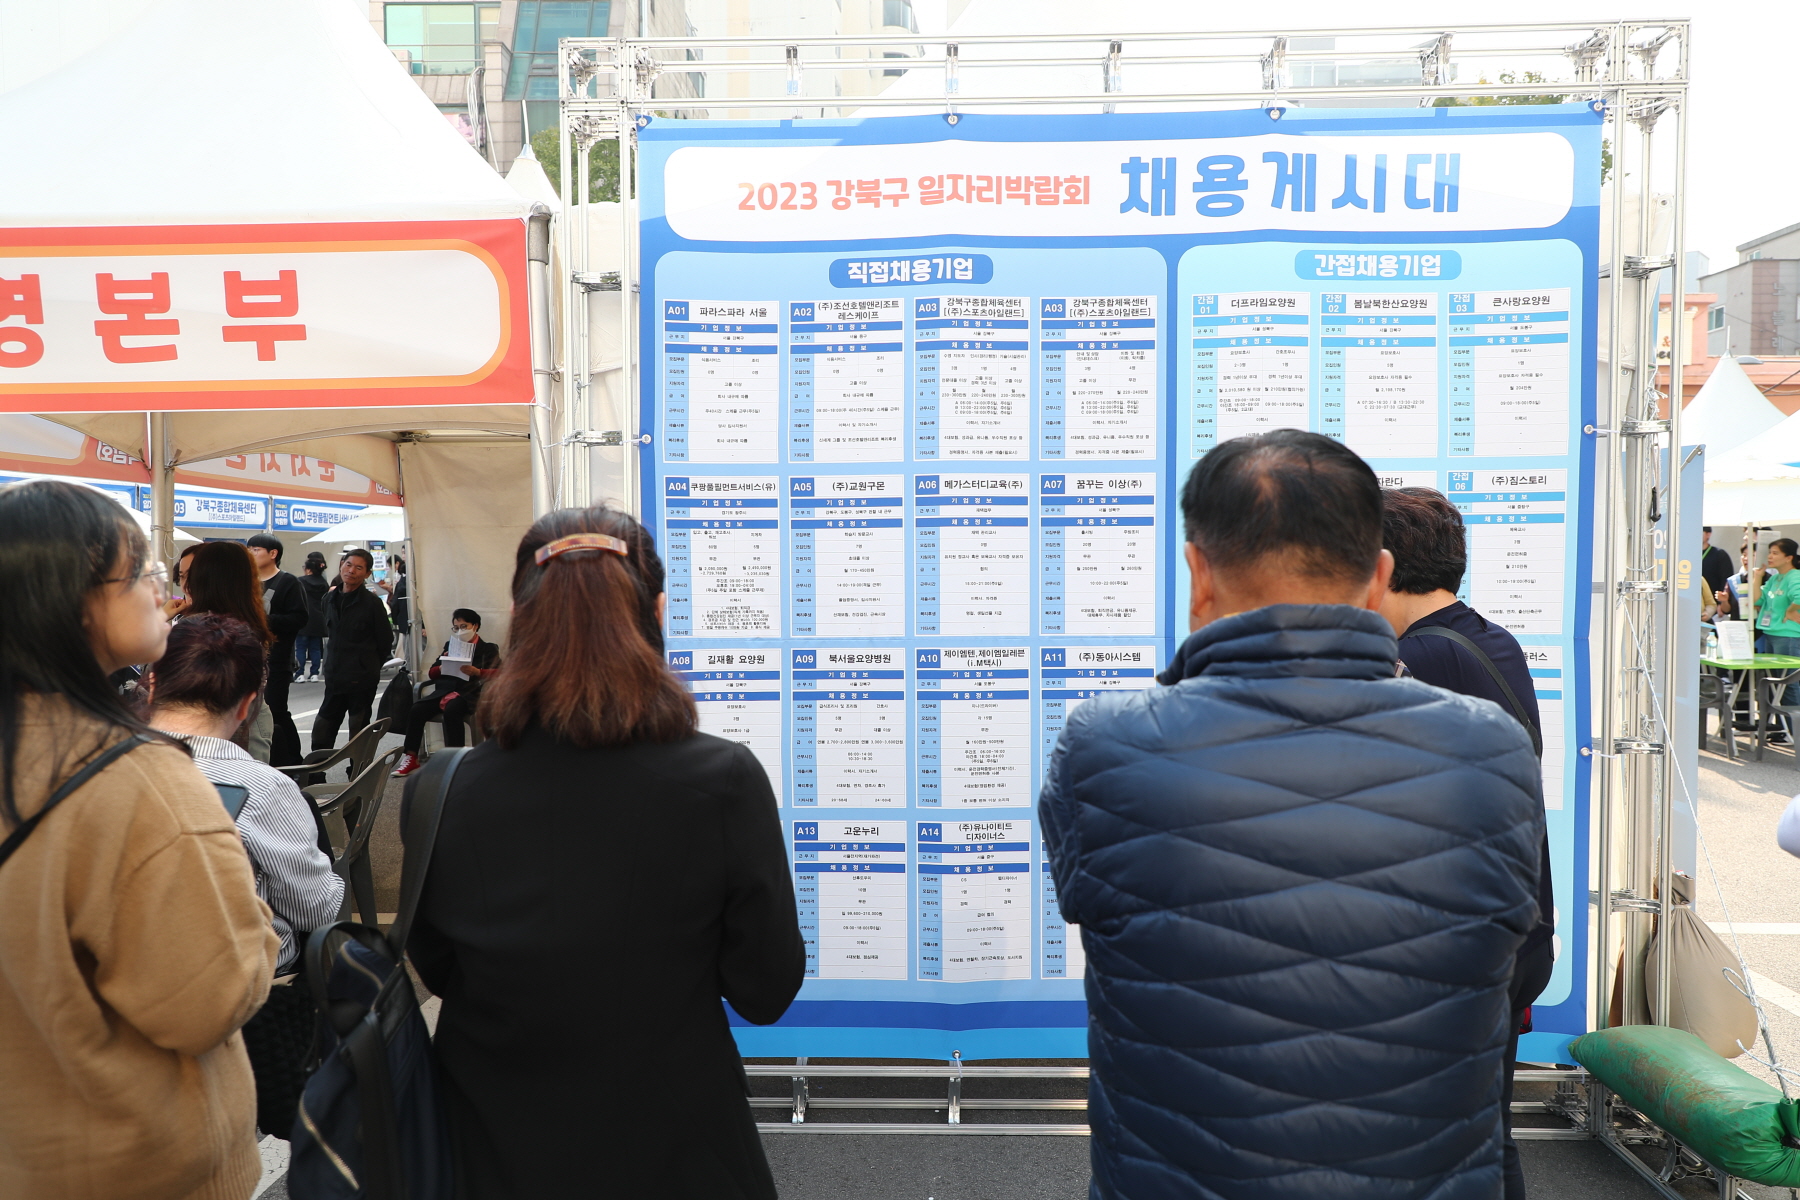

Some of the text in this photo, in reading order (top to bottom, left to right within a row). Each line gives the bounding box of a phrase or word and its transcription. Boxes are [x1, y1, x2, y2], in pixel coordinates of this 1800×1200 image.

[1120, 151, 1460, 217] 채용게시대
[738, 174, 1090, 210] 2023 강북구 일자리박람회
[1314, 254, 1441, 277] 간접채용기업
[846, 256, 974, 285] 직접채용기업
[1196, 295, 1215, 304] 간접
[1324, 293, 1344, 303] 간접
[1452, 293, 1471, 302] 간접
[1493, 296, 1550, 306] 큰사랑요양원
[818, 301, 899, 310] (주)조선호텔앤리조트
[947, 298, 1021, 309] 강북구종합체육센터
[1074, 298, 1149, 309] 강북구종합체육센터
[1231, 298, 1295, 307] 더프라임요양원
[1354, 299, 1427, 308] 봄날북한산요양원
[794, 308, 812, 316] A02
[919, 303, 937, 312] A03
[1044, 304, 1063, 312] A03
[1070, 306, 1150, 317] [(주)스포츠아일랜드]
[1200, 306, 1212, 315] 01
[1327, 305, 1340, 314] 02
[1455, 305, 1468, 314] 03
[700, 308, 767, 317] 파라스파라 서울
[838, 312, 879, 320] 레스케이프
[944, 308, 1024, 317] [(주)스포츠아일랜드]
[1451, 471, 1470, 481] 간접
[1492, 476, 1546, 485] (주)짐스토리
[689, 483, 775, 491] 쿠팡풀필먼트서비스(유)
[794, 483, 812, 491] A05
[833, 482, 885, 491] (주)교원구몬
[919, 481, 936, 489] A06
[945, 480, 1022, 489] 메가스터디교육(주)
[1044, 480, 1062, 488] A07
[1077, 480, 1142, 489] 꿈꾸는 이상(주)
[1454, 483, 1467, 492] 06
[195, 499, 257, 514] 강북구종합체육센터
[293, 511, 305, 521] A04
[672, 657, 690, 665] A08
[708, 655, 764, 664] 길재활 요양원
[796, 655, 813, 663] A09
[829, 654, 890, 663] 북서울요양병원
[1044, 653, 1061, 661] A11
[1079, 653, 1140, 662] (주)동아시스템
[844, 827, 878, 835] 고운누리
[959, 823, 1012, 831] (주)유나이티드
[921, 828, 939, 836] A14
